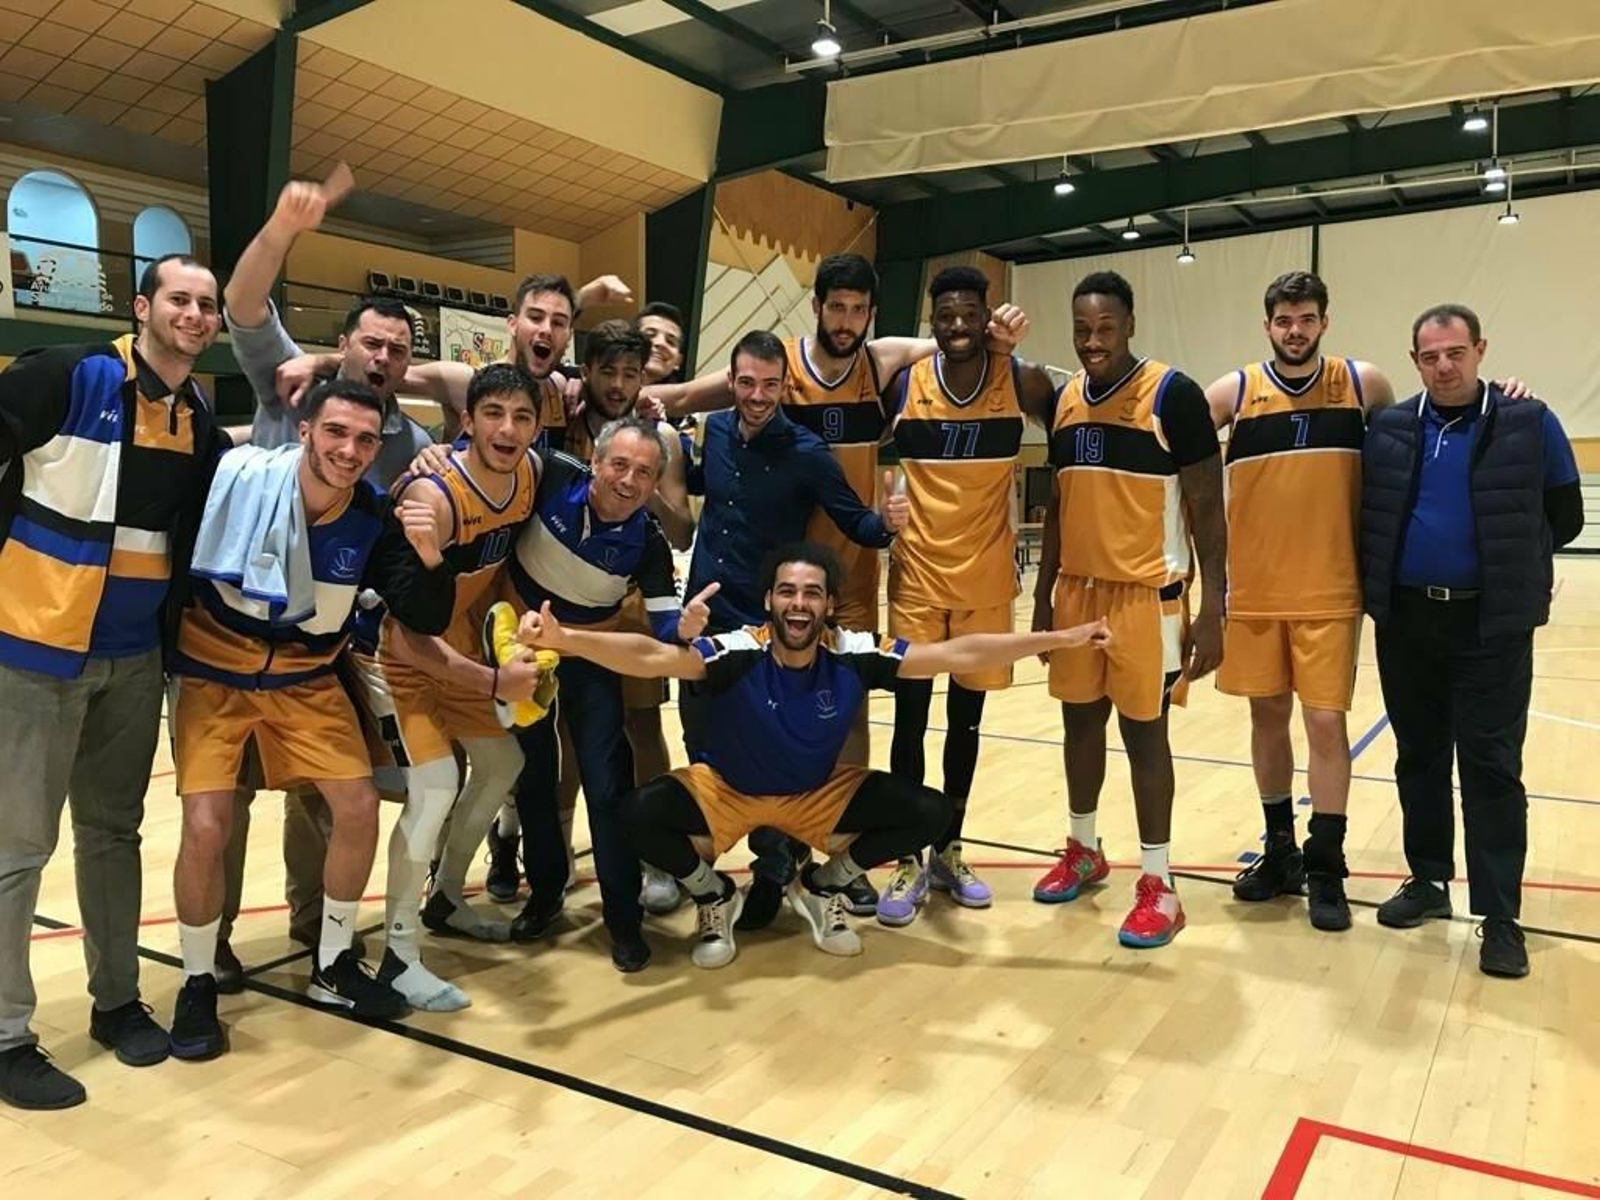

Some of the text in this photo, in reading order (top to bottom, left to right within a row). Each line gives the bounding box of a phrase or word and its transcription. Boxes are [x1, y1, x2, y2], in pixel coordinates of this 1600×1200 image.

[474, 332, 503, 354] San
[823, 407, 844, 440] 9
[941, 423, 981, 457] 77
[1290, 413, 1310, 448] 7
[1074, 427, 1105, 463] 19
[478, 528, 511, 567] 10
